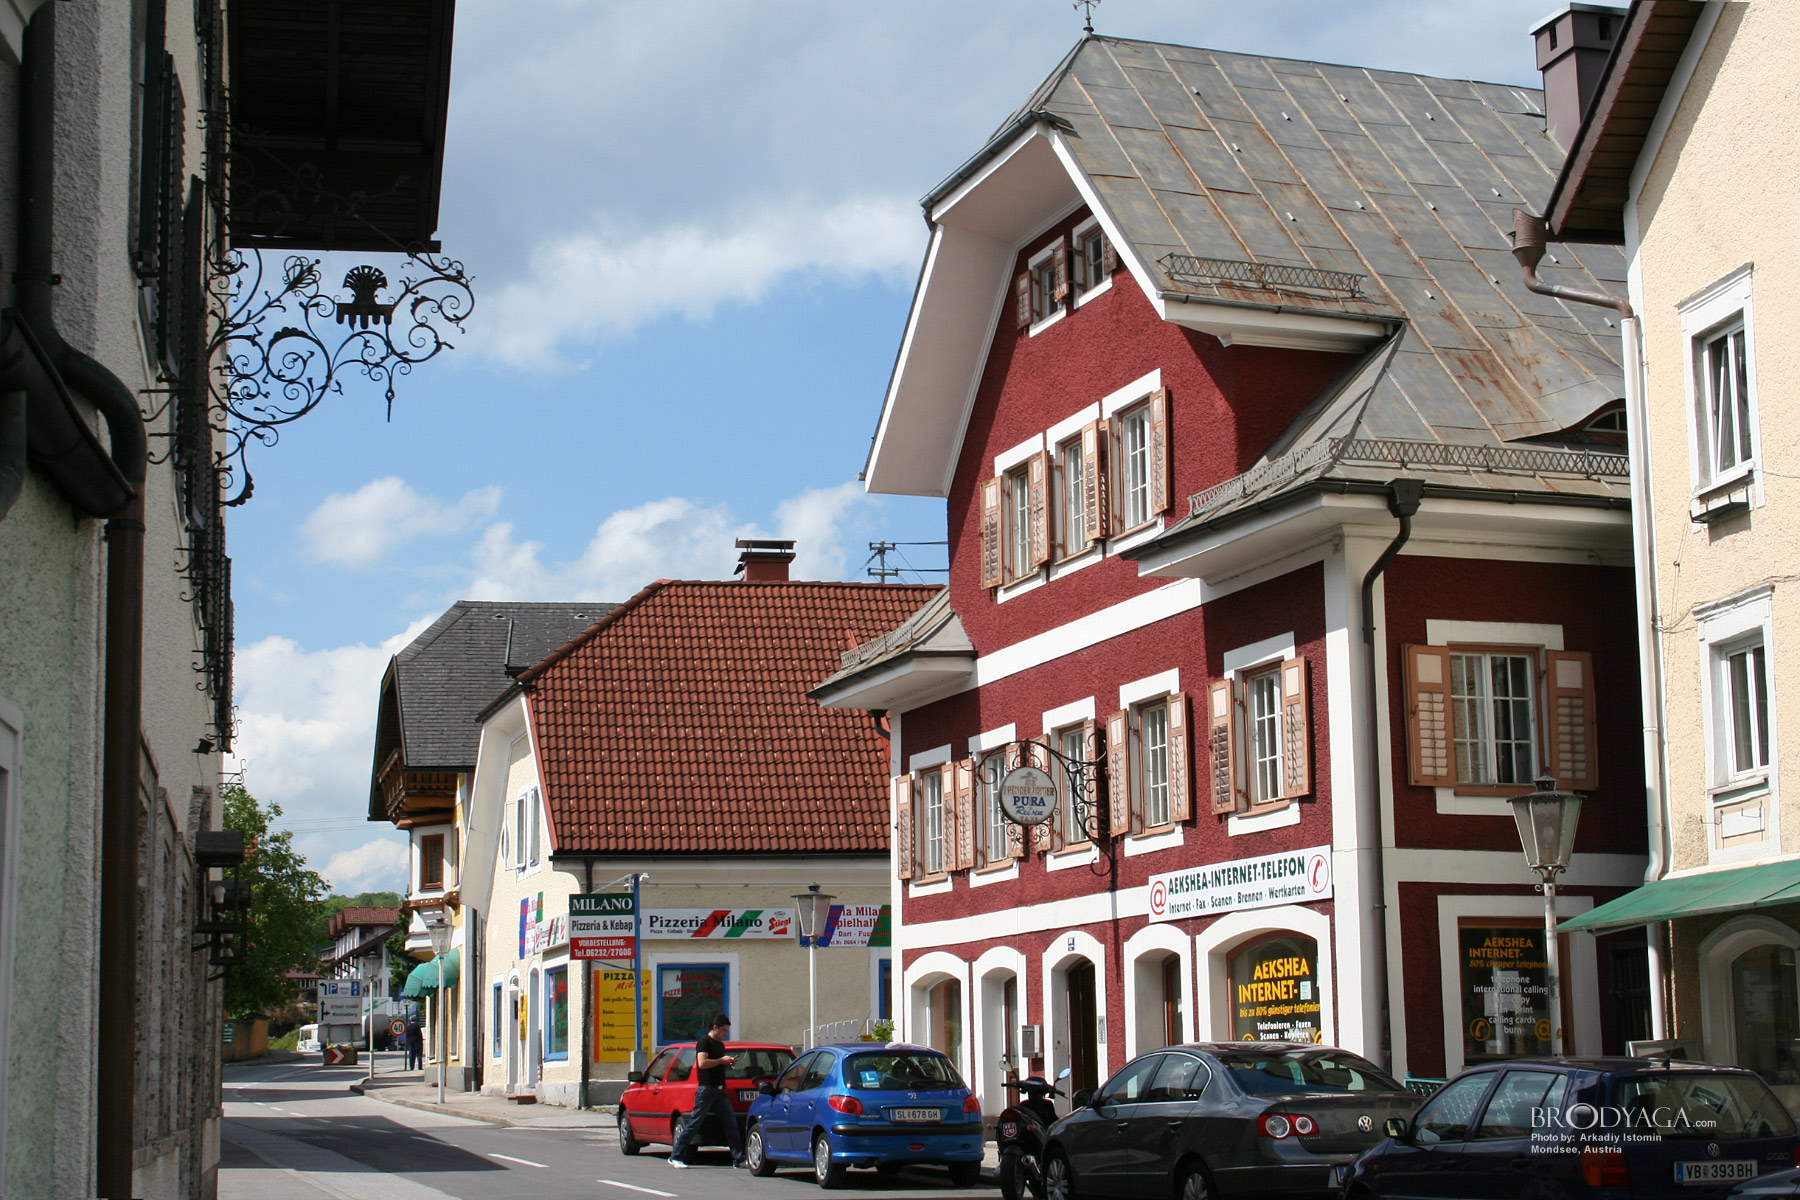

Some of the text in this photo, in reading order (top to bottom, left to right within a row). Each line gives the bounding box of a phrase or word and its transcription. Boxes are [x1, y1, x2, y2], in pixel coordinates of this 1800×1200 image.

[1013, 796, 1046, 807] PURA
[572, 898, 633, 910] MILANO
[1169, 884, 1306, 914] Internet Fax Scanen Brennen Wertkarten
[855, 906, 890, 917] Milano
[572, 920, 601, 931] Pizzeria
[602, 920, 608, 930] &
[610, 919, 633, 932] Kebap
[649, 915, 763, 928] Pizzeria Milano
[830, 918, 882, 929] Spielhalle
[1483, 937, 1534, 948] AEKSHEA
[1253, 957, 1310, 981] AEKSHEA
[1516, 961, 1549, 969] telephon
[603, 973, 635, 981] PIZZA
[1491, 975, 1531, 985] teephone
[614, 979, 650, 992] Milo
[1238, 979, 1298, 1003] INTERNET-
[1523, 985, 1549, 995] calling
[1267, 1004, 1293, 1016] günstiger
[1293, 1001, 1320, 1014] telefonier
[1257, 1021, 1290, 1030] Telefonieren
[1488, 1015, 1536, 1025] calling cards
[393, 1022, 403, 1033] 40
[897, 1111, 906, 1119] SL
[1686, 1163, 1753, 1179] VB 393 BH
